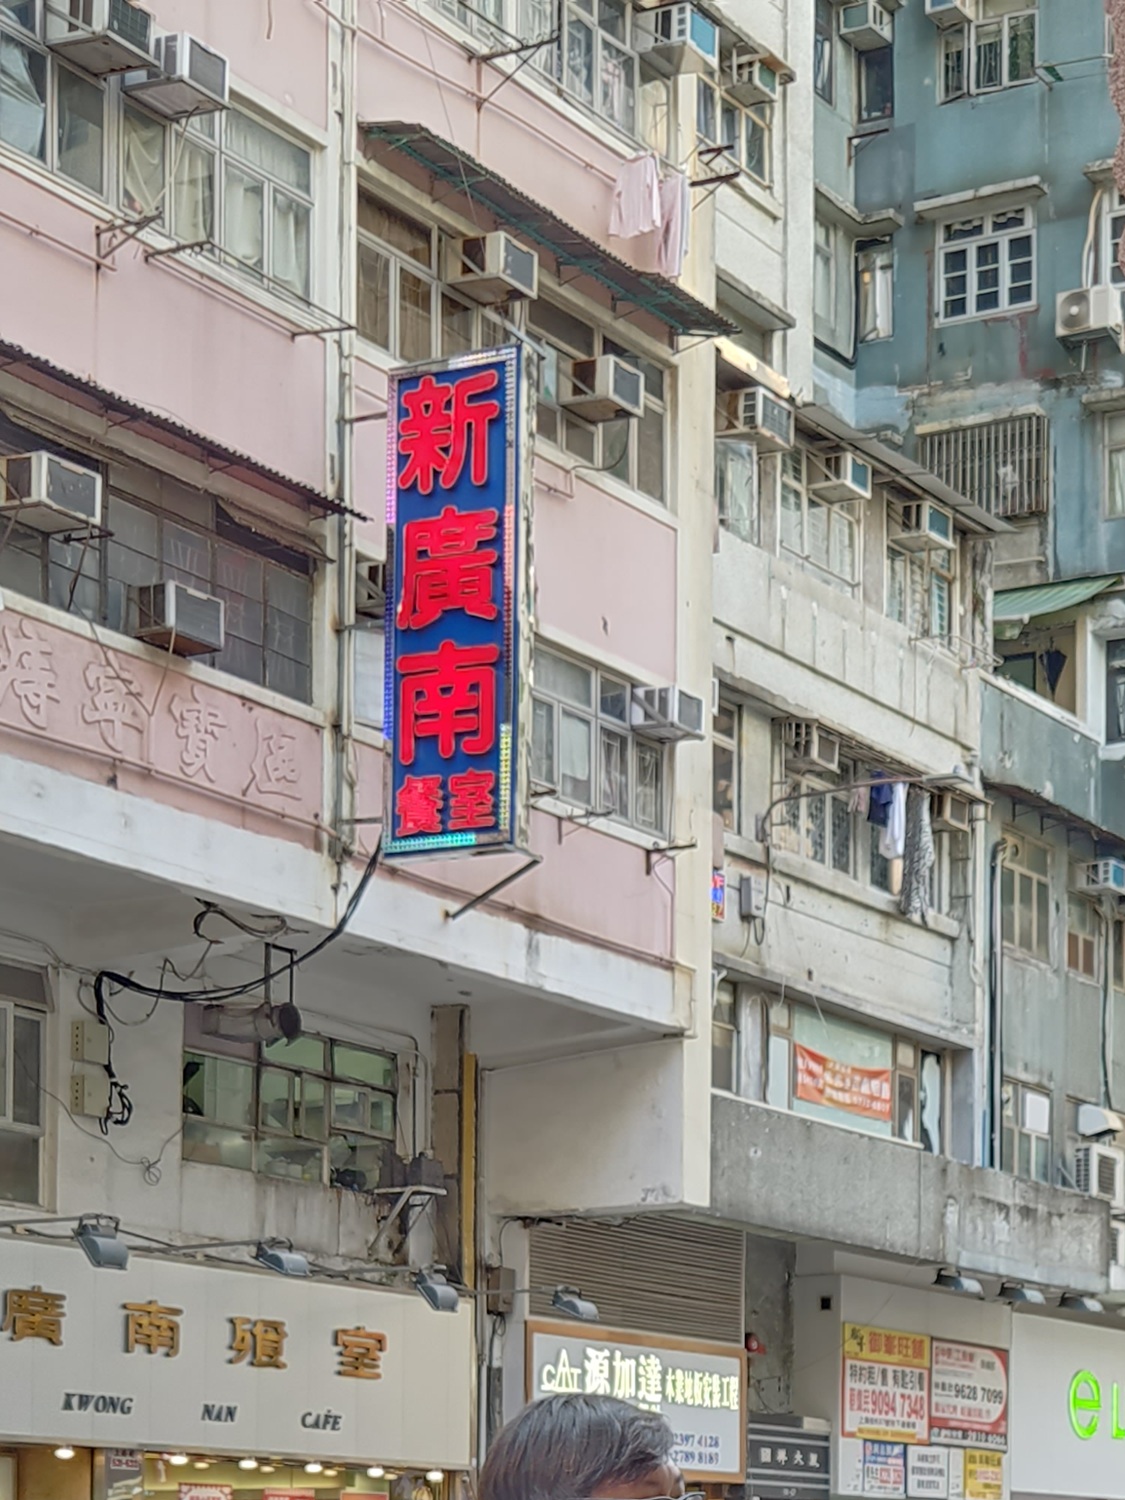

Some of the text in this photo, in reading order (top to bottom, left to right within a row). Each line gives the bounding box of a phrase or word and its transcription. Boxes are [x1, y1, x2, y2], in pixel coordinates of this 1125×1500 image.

[395, 369, 500, 766] 新廣南
[395, 768, 496, 836] 餐室
[61, 1392, 134, 1415] KWONG
[201, 1403, 238, 1423] NAN
[1069, 1369, 1102, 1440] e
